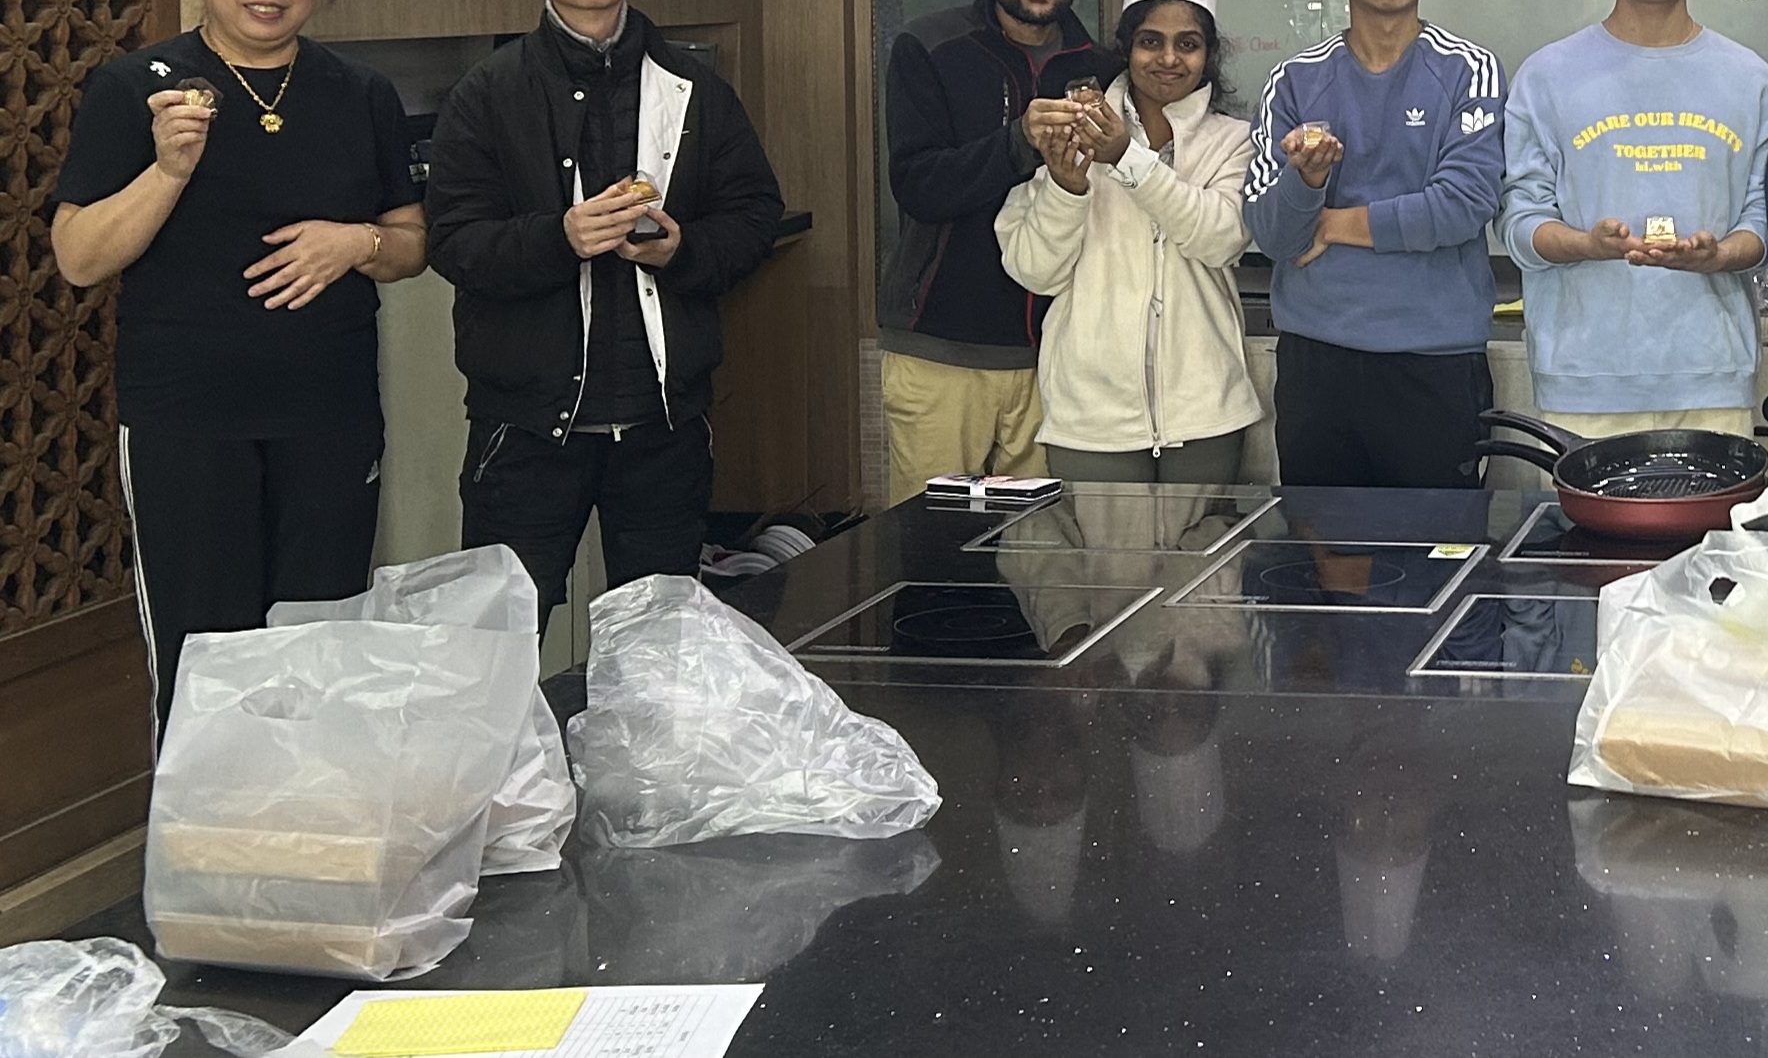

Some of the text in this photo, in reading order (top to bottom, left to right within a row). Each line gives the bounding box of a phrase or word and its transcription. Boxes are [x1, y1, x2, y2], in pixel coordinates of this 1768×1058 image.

[1572, 111, 1743, 153] SHARE OUR HEARTS
[1613, 144, 1707, 160] TOGETHER
